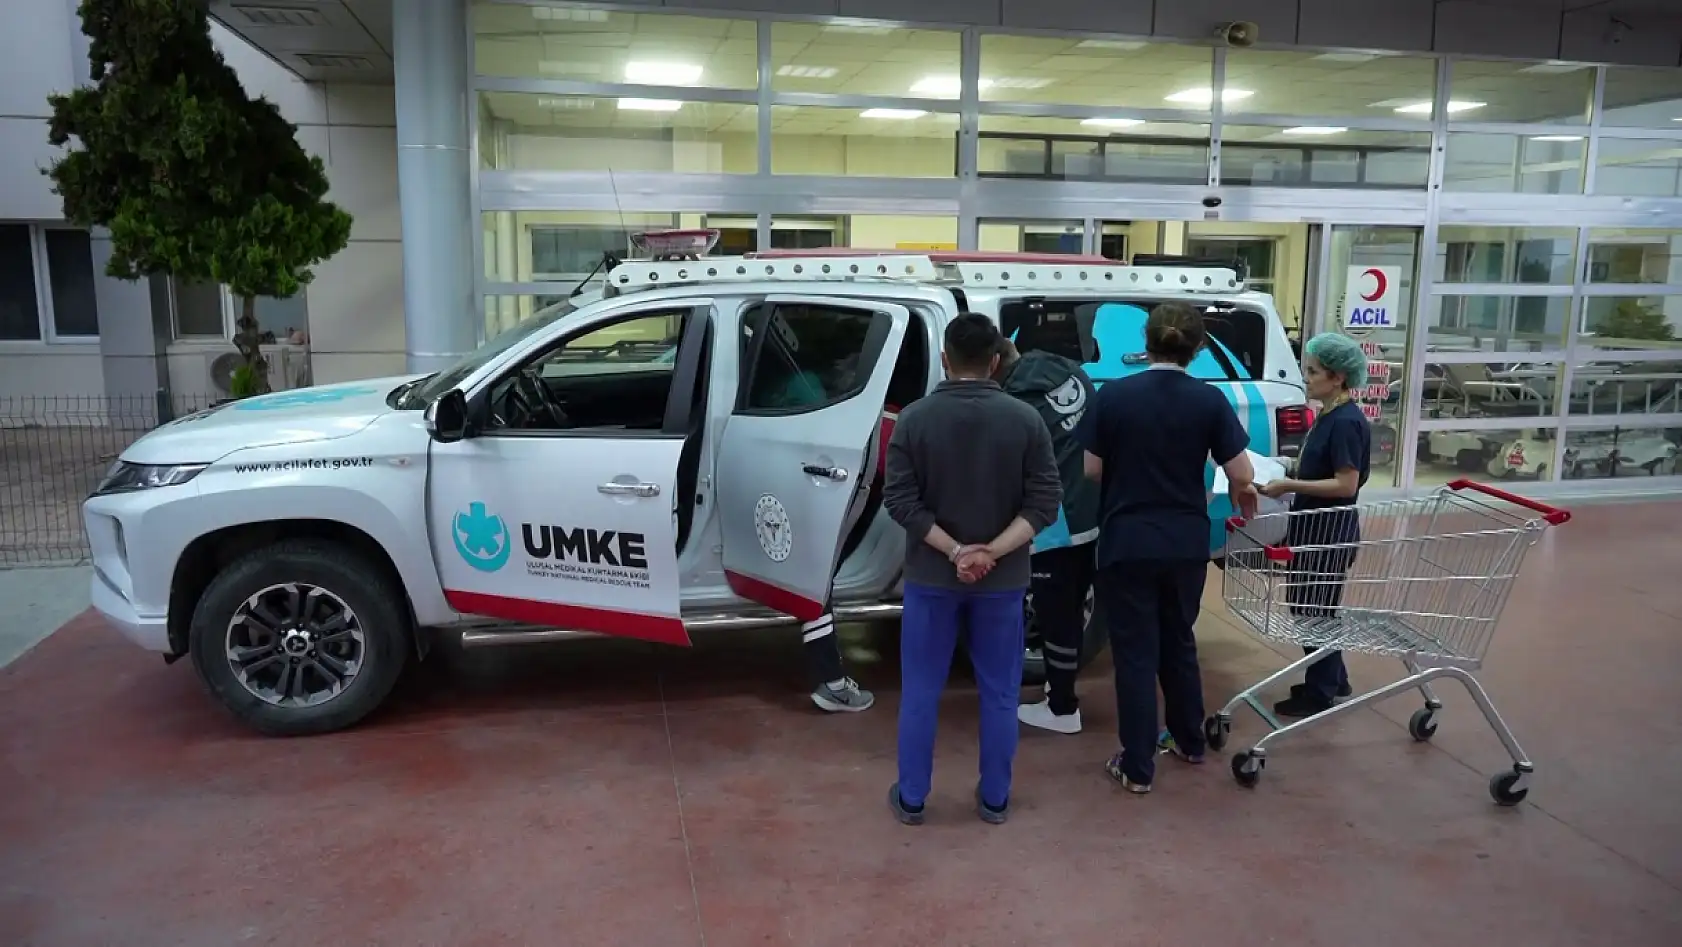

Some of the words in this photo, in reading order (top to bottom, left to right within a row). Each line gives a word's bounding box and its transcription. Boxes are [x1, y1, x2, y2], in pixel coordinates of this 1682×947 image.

[234, 457, 374, 474] www.acilafet.gov.tr
[521, 522, 648, 569] UMKE
[526, 560, 554, 571] ULUSAL
[587, 567, 628, 578] KURTARMA
[632, 580, 650, 590] TEAM
